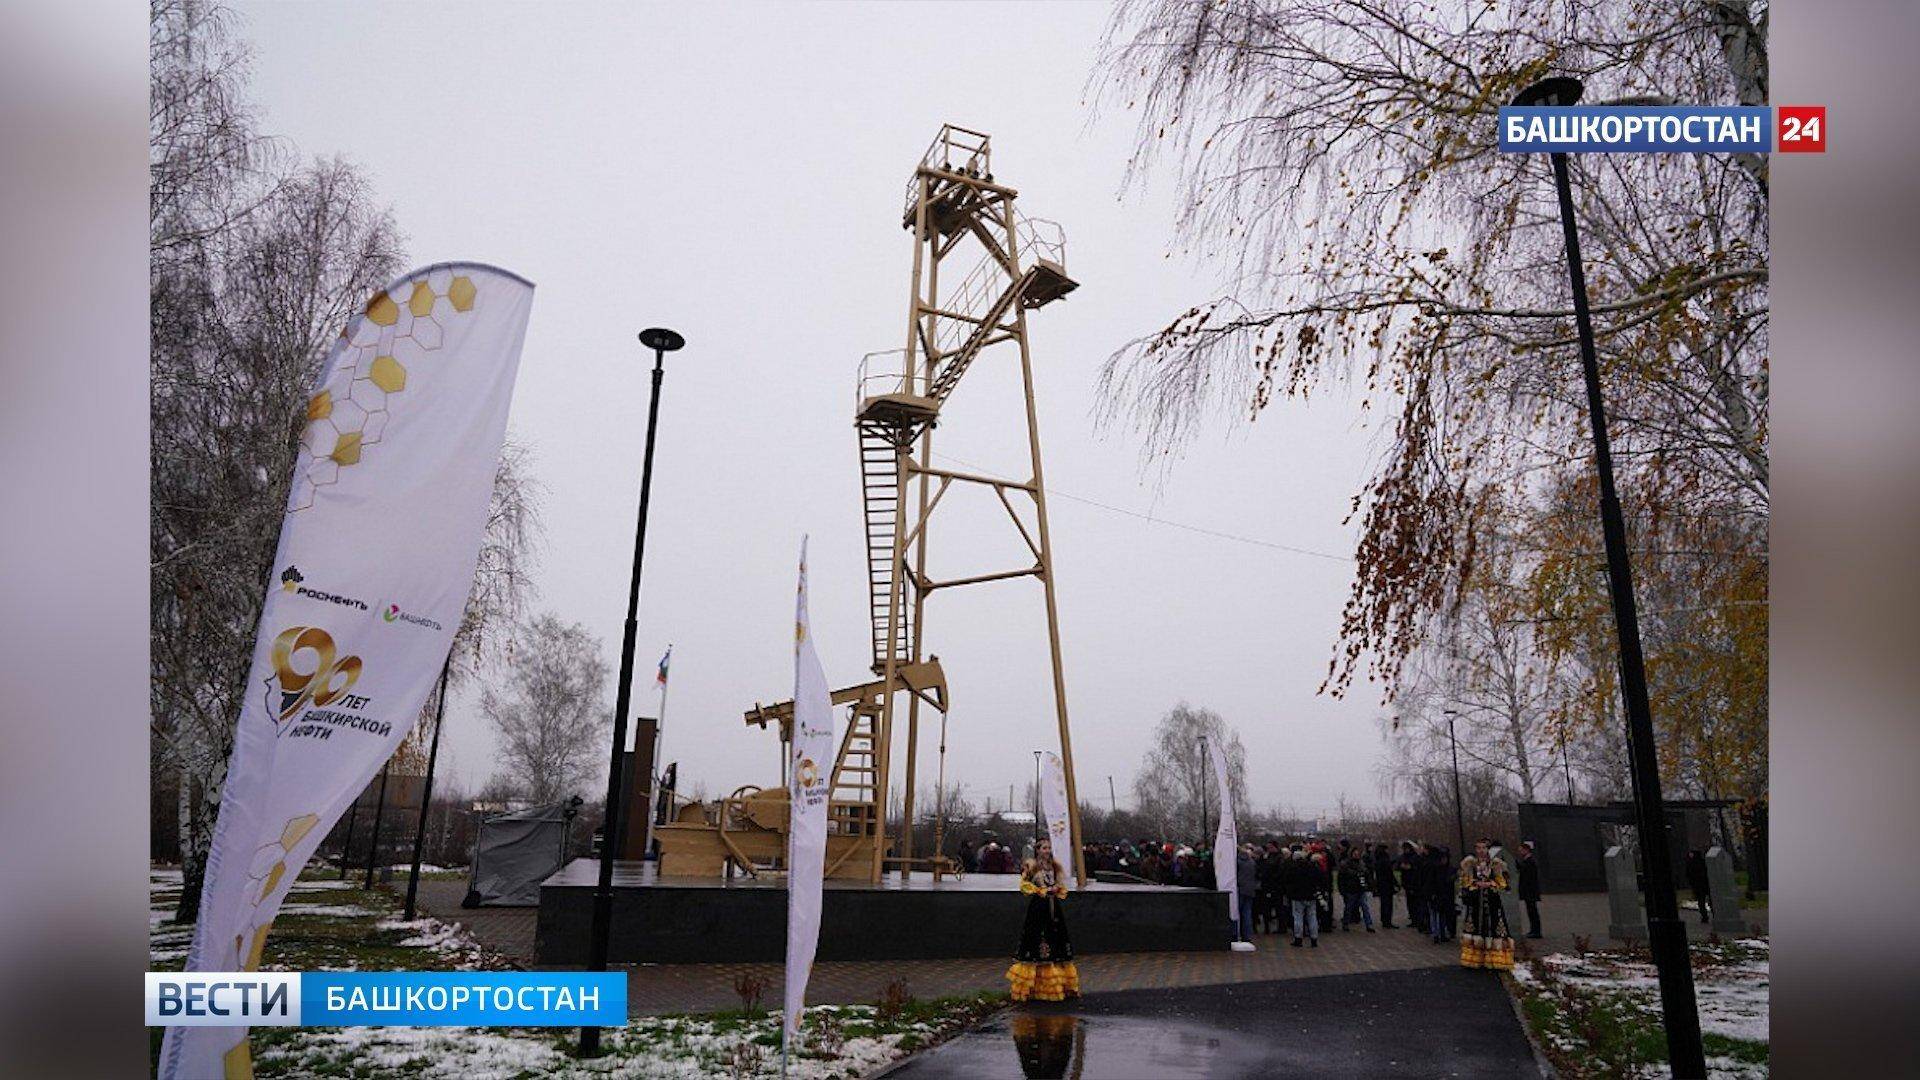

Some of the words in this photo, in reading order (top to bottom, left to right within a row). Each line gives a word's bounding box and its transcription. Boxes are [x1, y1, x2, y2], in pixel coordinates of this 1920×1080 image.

[297, 587, 368, 611] РОСНЕФТЬ
[338, 694, 371, 710] ЛЕТ
[289, 725, 333, 740] НФТИ
[301, 710, 392, 737] БШКИРСКОЙ
